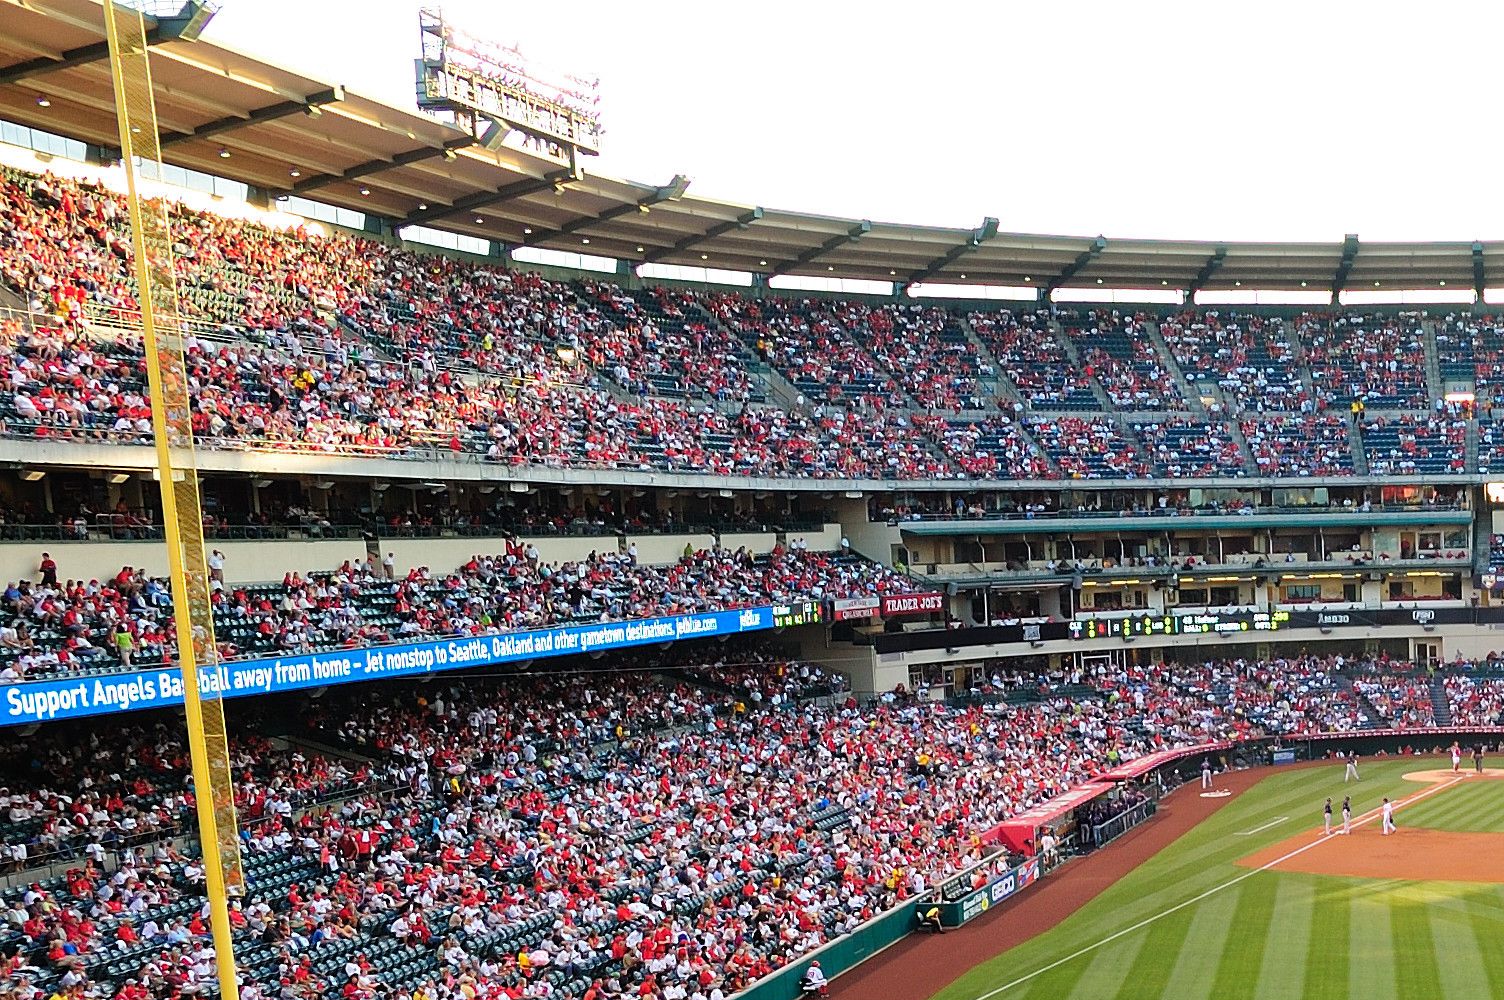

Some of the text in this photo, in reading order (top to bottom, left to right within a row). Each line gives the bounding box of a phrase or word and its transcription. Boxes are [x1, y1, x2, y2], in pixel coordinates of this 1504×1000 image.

[886, 598, 918, 612] TRADER
[920, 596, 943, 609] JOE'S
[7, 682, 89, 720] Support
[93, 675, 156, 710] Angels
[159, 666, 232, 699] Basball
[234, 666, 272, 692] away
[275, 660, 311, 684] from
[313, 656, 351, 680] home
[364, 651, 385, 674] Jet
[386, 647, 435, 672] nonstop
[435, 644, 448, 664] to
[450, 638, 492, 663] Seattle,
[492, 633, 534, 658] Oakland
[534, 631, 553, 651] and
[554, 629, 580, 650] other
[580, 626, 625, 651] gametown
[625, 619, 675, 642] destinations.
